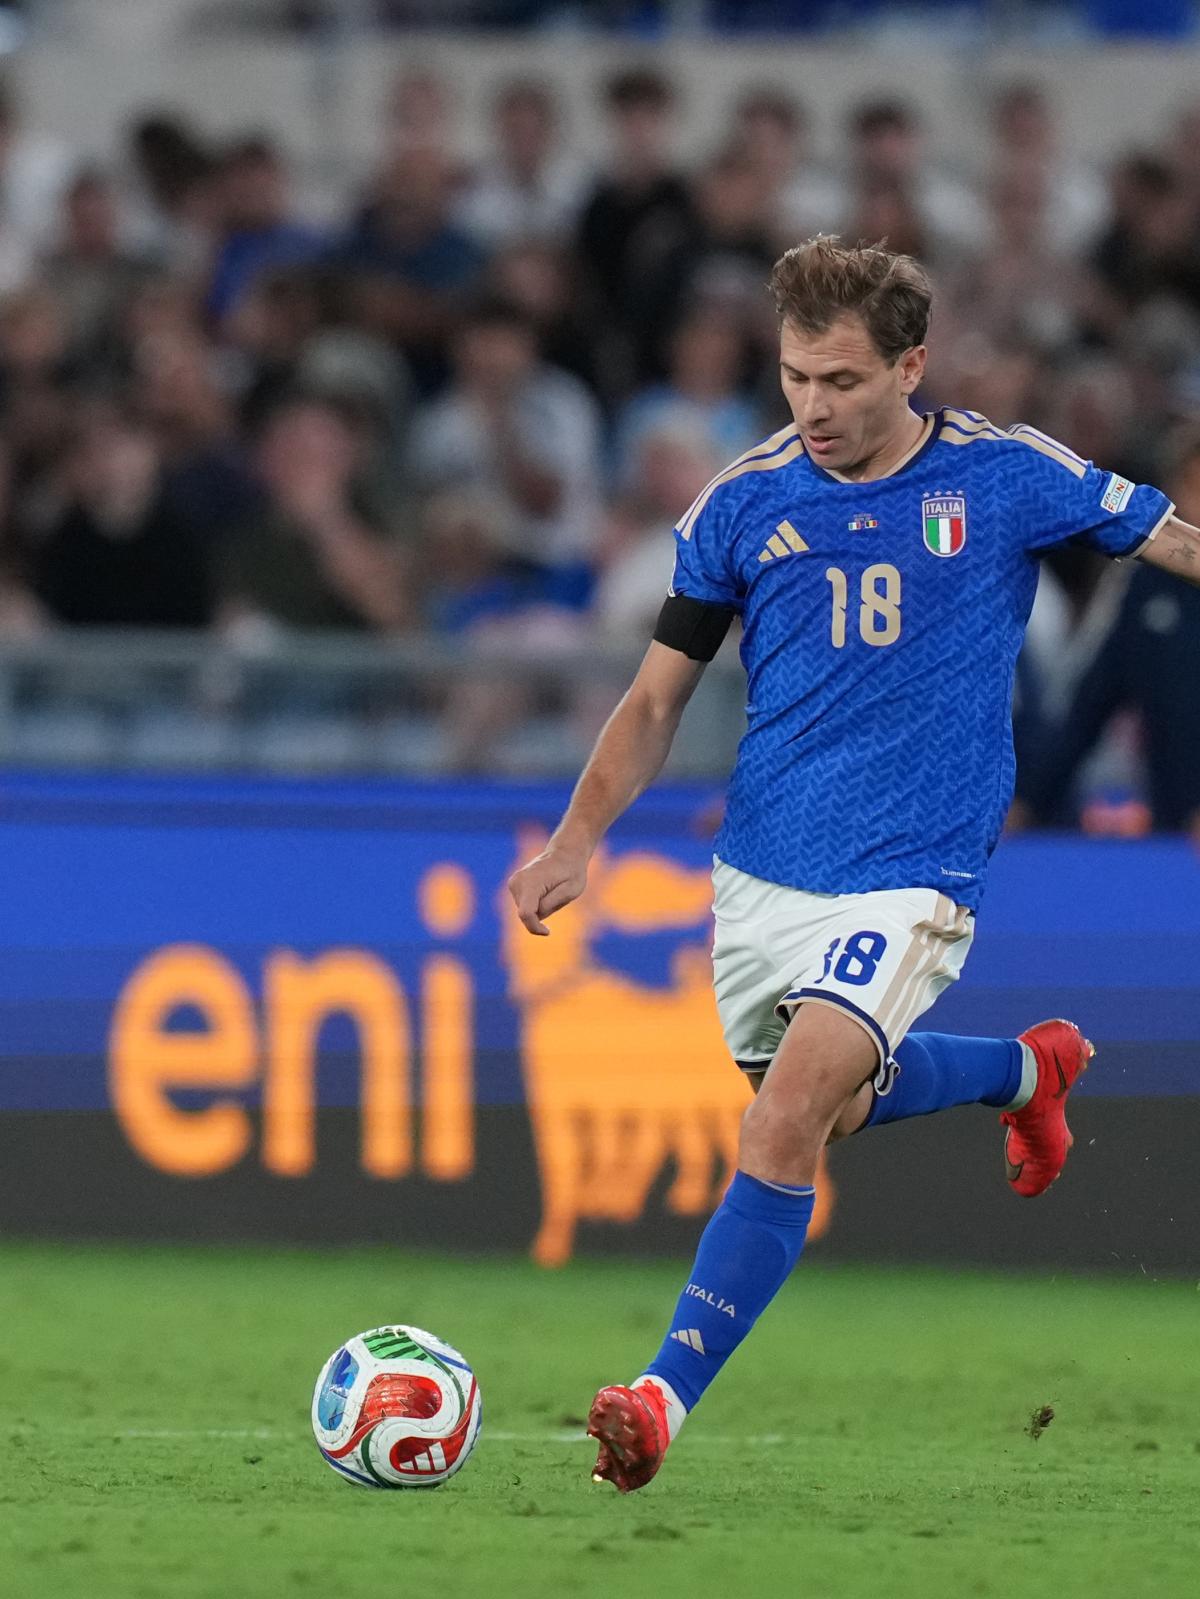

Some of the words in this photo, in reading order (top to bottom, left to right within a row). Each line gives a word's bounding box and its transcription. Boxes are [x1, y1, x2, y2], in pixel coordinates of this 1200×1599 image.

[926, 502, 961, 515] ITALIA
[825, 563, 901, 649] 18
[109, 864, 475, 1179] eni
[685, 1283, 735, 1318] ITALIA
